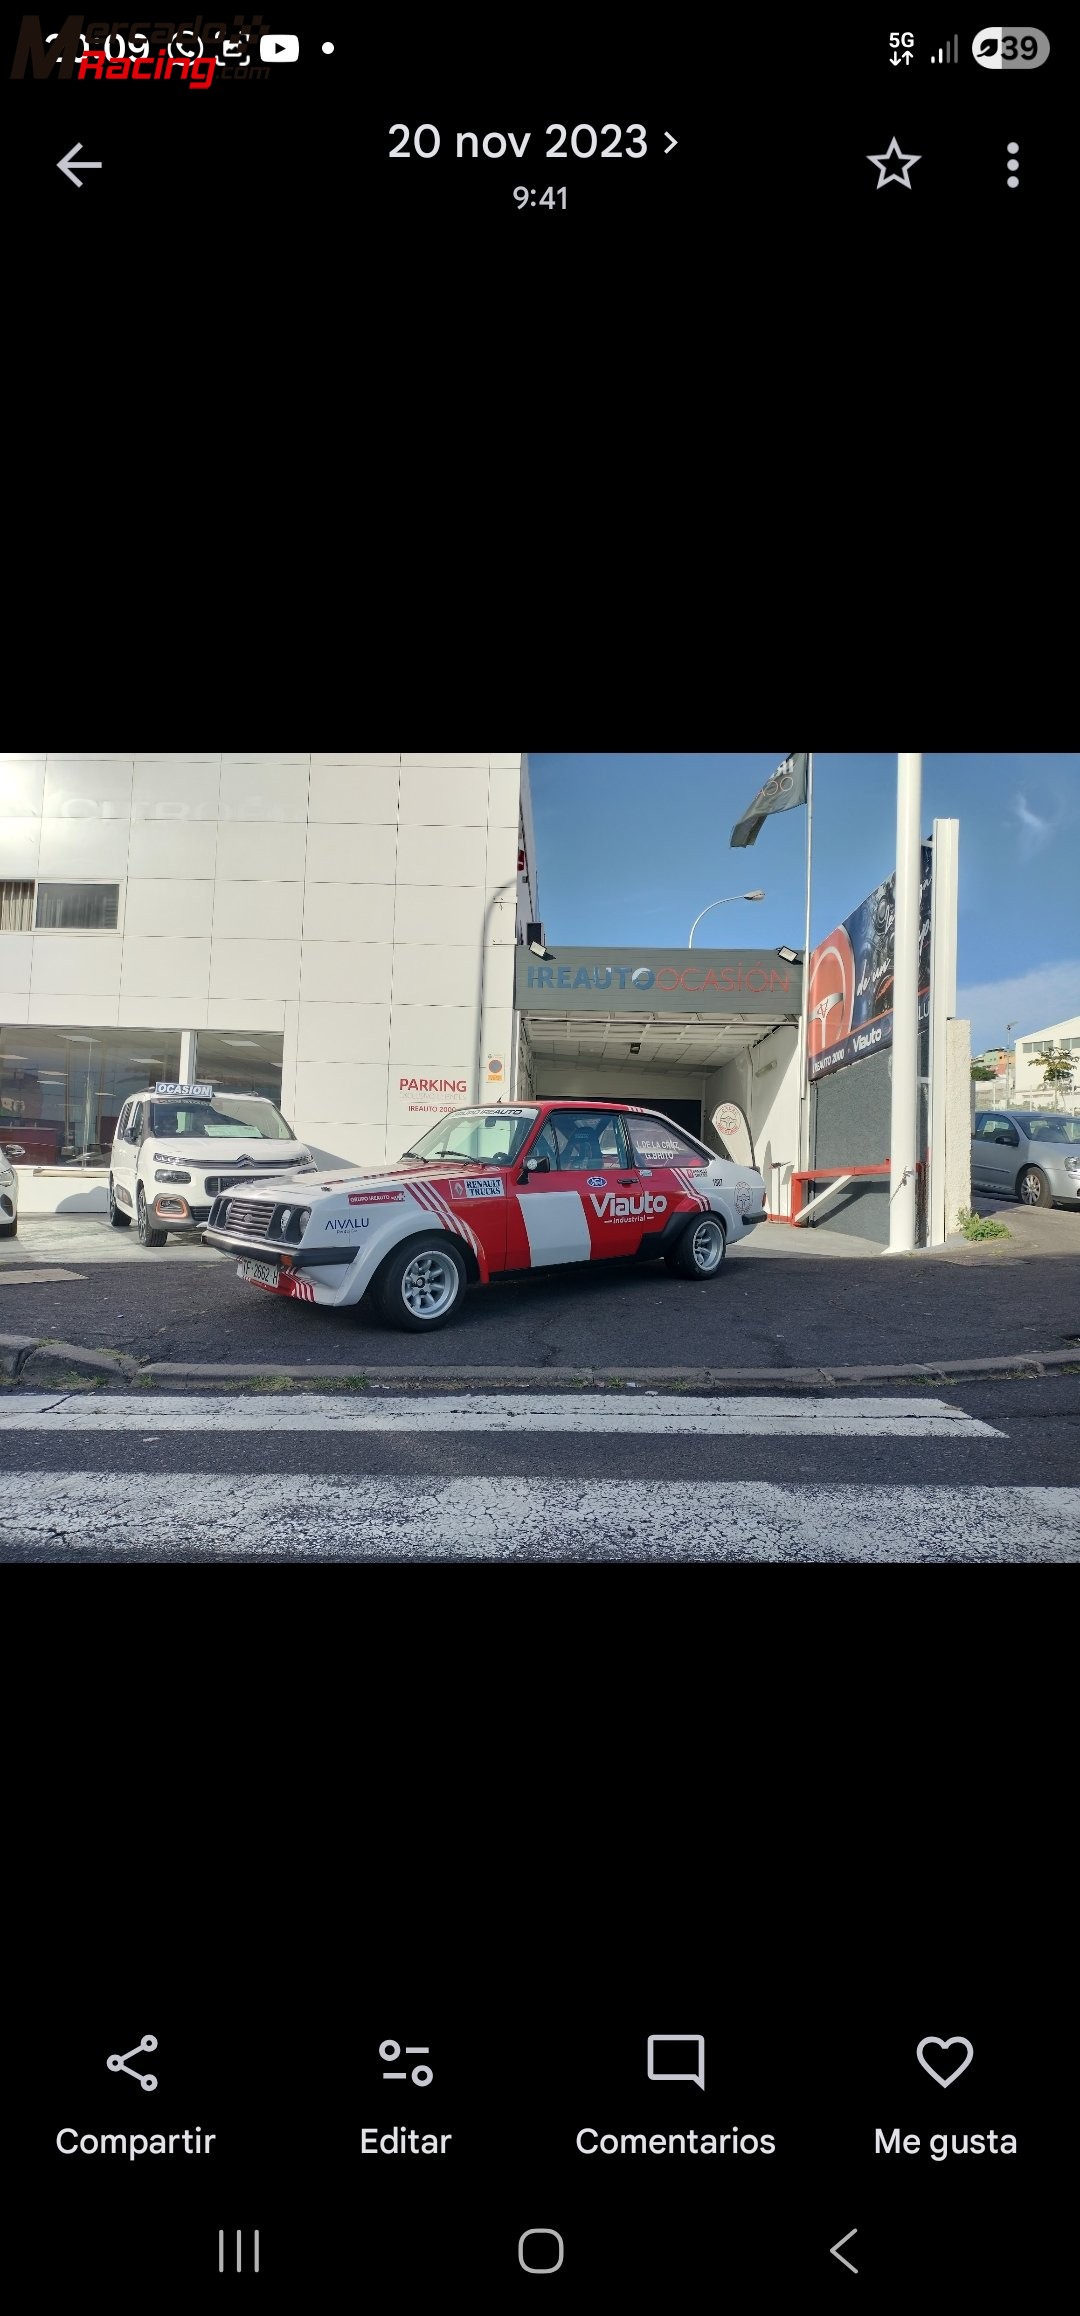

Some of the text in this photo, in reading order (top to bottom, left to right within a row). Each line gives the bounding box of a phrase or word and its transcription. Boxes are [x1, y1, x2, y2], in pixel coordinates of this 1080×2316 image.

[889, 32, 915, 48] 5G
[1001, 35, 1038, 61] 39
[388, 124, 648, 159] 20 nov 2023
[512, 186, 567, 210] 9:41
[852, 1026, 882, 1053] Viauto
[158, 1084, 210, 1096] OCASION
[399, 1078, 467, 1093] PARKING
[408, 1105, 438, 1113] IREAUTO
[466, 1179, 501, 1189] RENAULT
[469, 1187, 501, 1196] TRUCKS
[590, 1191, 668, 1218] Viauto
[325, 1217, 370, 1231] AIVALU
[612, 1215, 646, 1224] industrial
[56, 2126, 217, 2162] Compartir
[361, 2126, 453, 2155] Editar
[575, 2126, 776, 2155] Comentarios
[875, 2127, 1017, 2162] Me gusta
